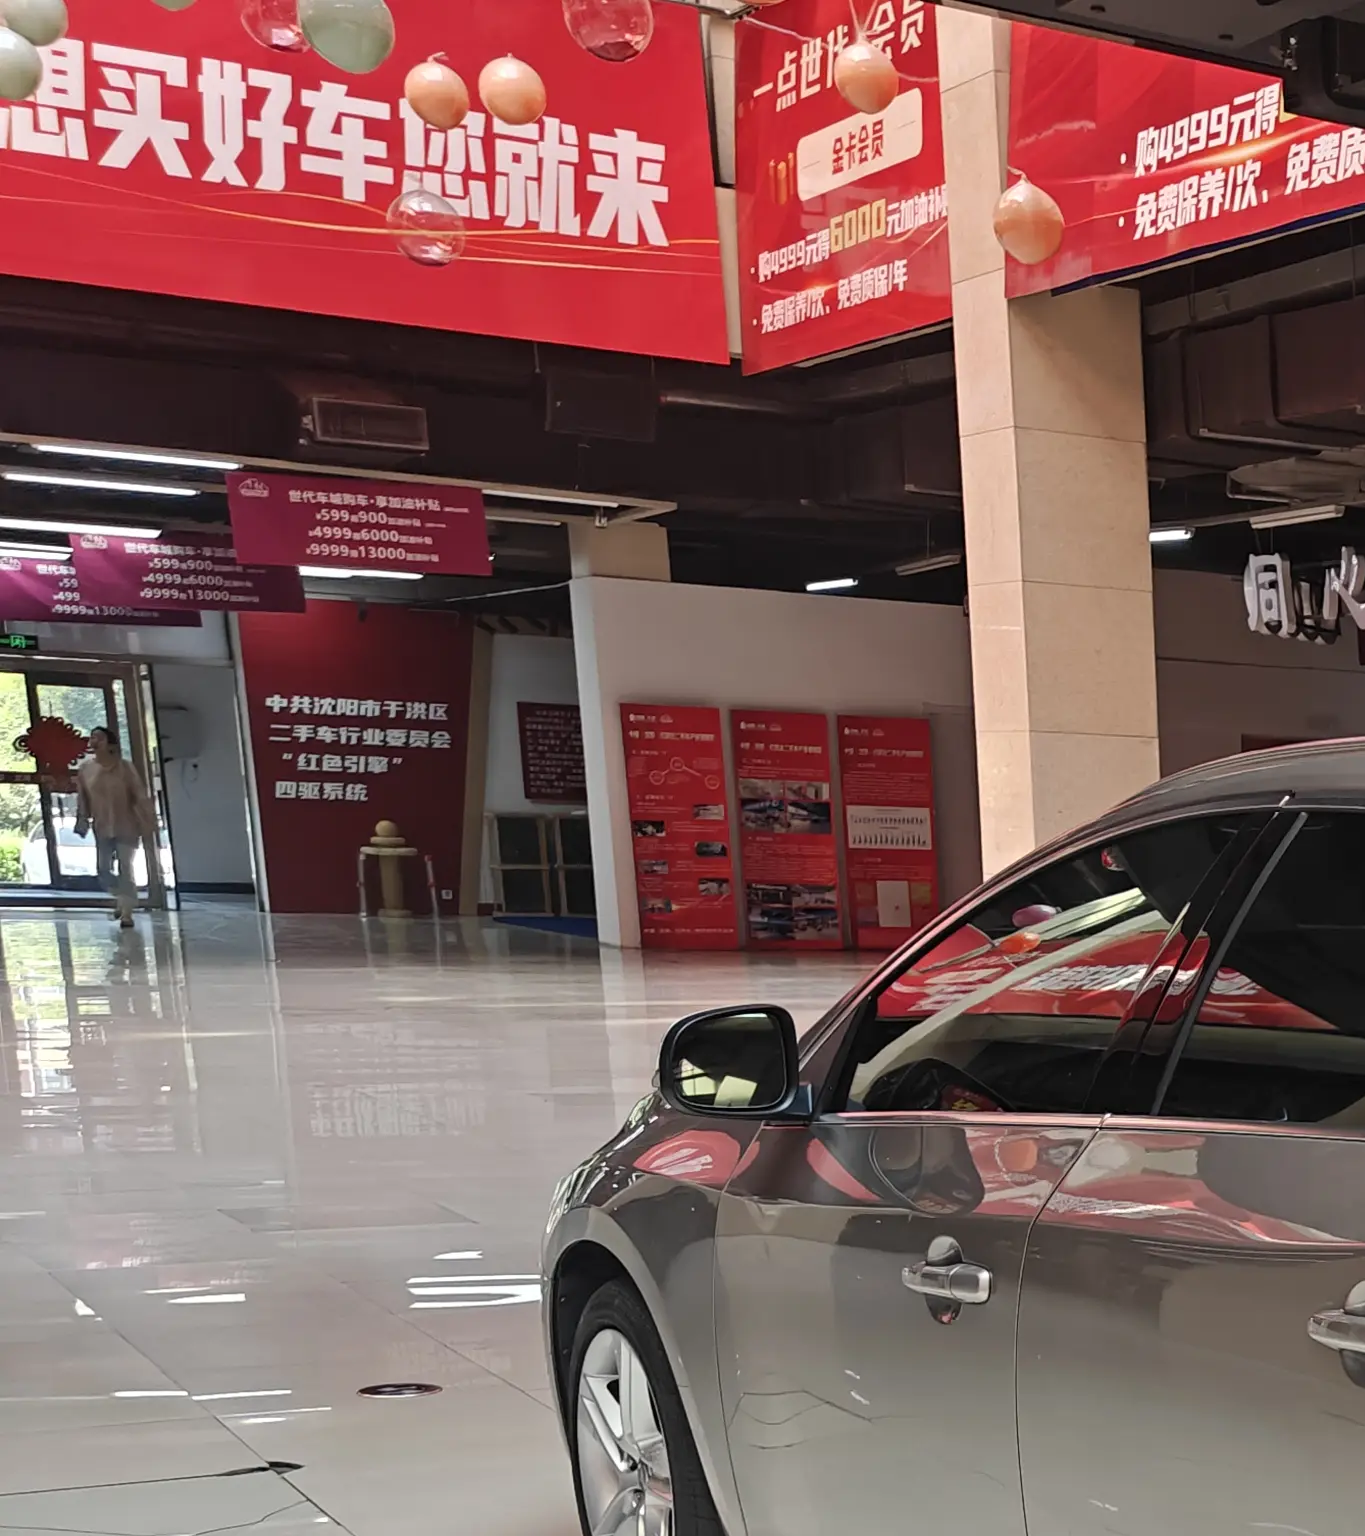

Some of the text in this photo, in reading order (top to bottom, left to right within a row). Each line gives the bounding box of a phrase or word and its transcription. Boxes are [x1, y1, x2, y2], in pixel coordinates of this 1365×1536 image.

[1134, 82, 1296, 177] 购4999元得
[832, 118, 884, 176] 金卡会员
[265, 694, 450, 721] 中共沈阳市于洪区
[268, 723, 452, 749] 二手车行业委员会
[275, 781, 369, 802] 四驱系统
